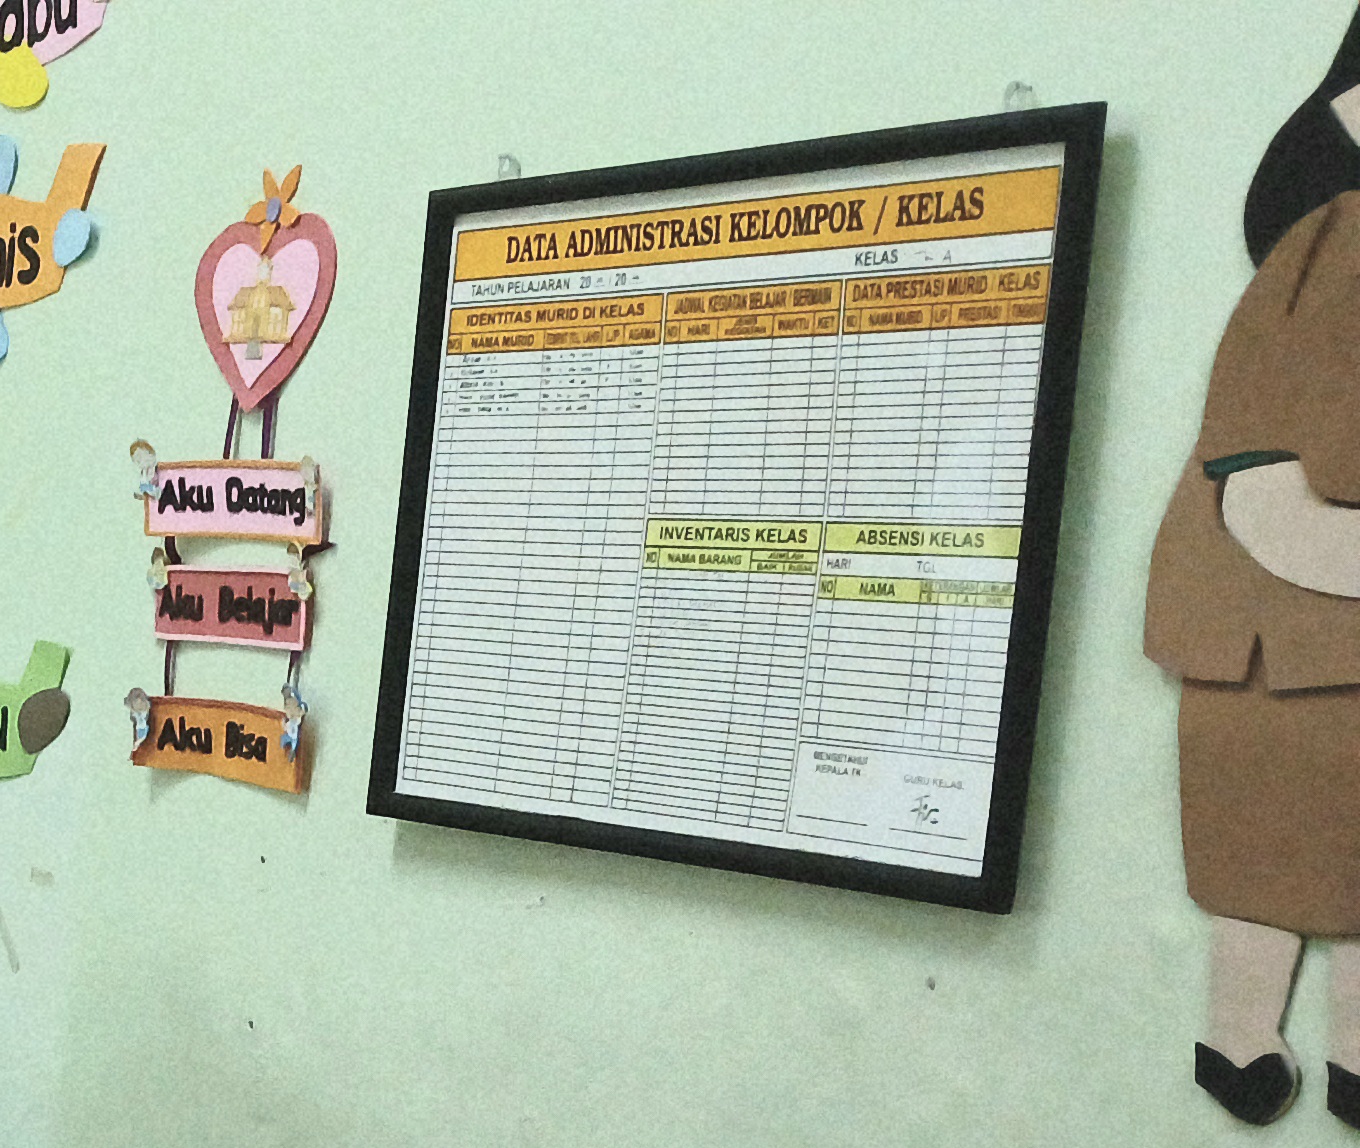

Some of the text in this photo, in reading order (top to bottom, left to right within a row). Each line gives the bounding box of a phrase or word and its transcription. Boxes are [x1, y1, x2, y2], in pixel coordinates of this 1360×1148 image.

[506, 186, 985, 264] DATA ADMINISTRASI KELOMPOK / KELAS
[854, 249, 899, 266] KELAS
[471, 283, 505, 298] TAHUN
[507, 278, 570, 295] PELAJARAN
[615, 272, 627, 287] 20
[852, 284, 883, 302] DATA
[886, 279, 944, 299] PRESTASI
[947, 275, 988, 296] MURID
[998, 270, 1042, 293] KELAS
[466, 303, 645, 327] IDENTITAS MURID DI KELAS
[157, 476, 306, 527] Aku Datang
[659, 526, 808, 544] INVENTARIS KELAS
[855, 529, 985, 548] ABSENSI KELAS
[698, 553, 742, 565] BARANG
[826, 558, 852, 570] HARI
[859, 582, 896, 597] NAMA
[158, 584, 300, 635] Aku Belajar
[157, 716, 268, 764] Aku Bisa
[903, 774, 929, 786] GURU
